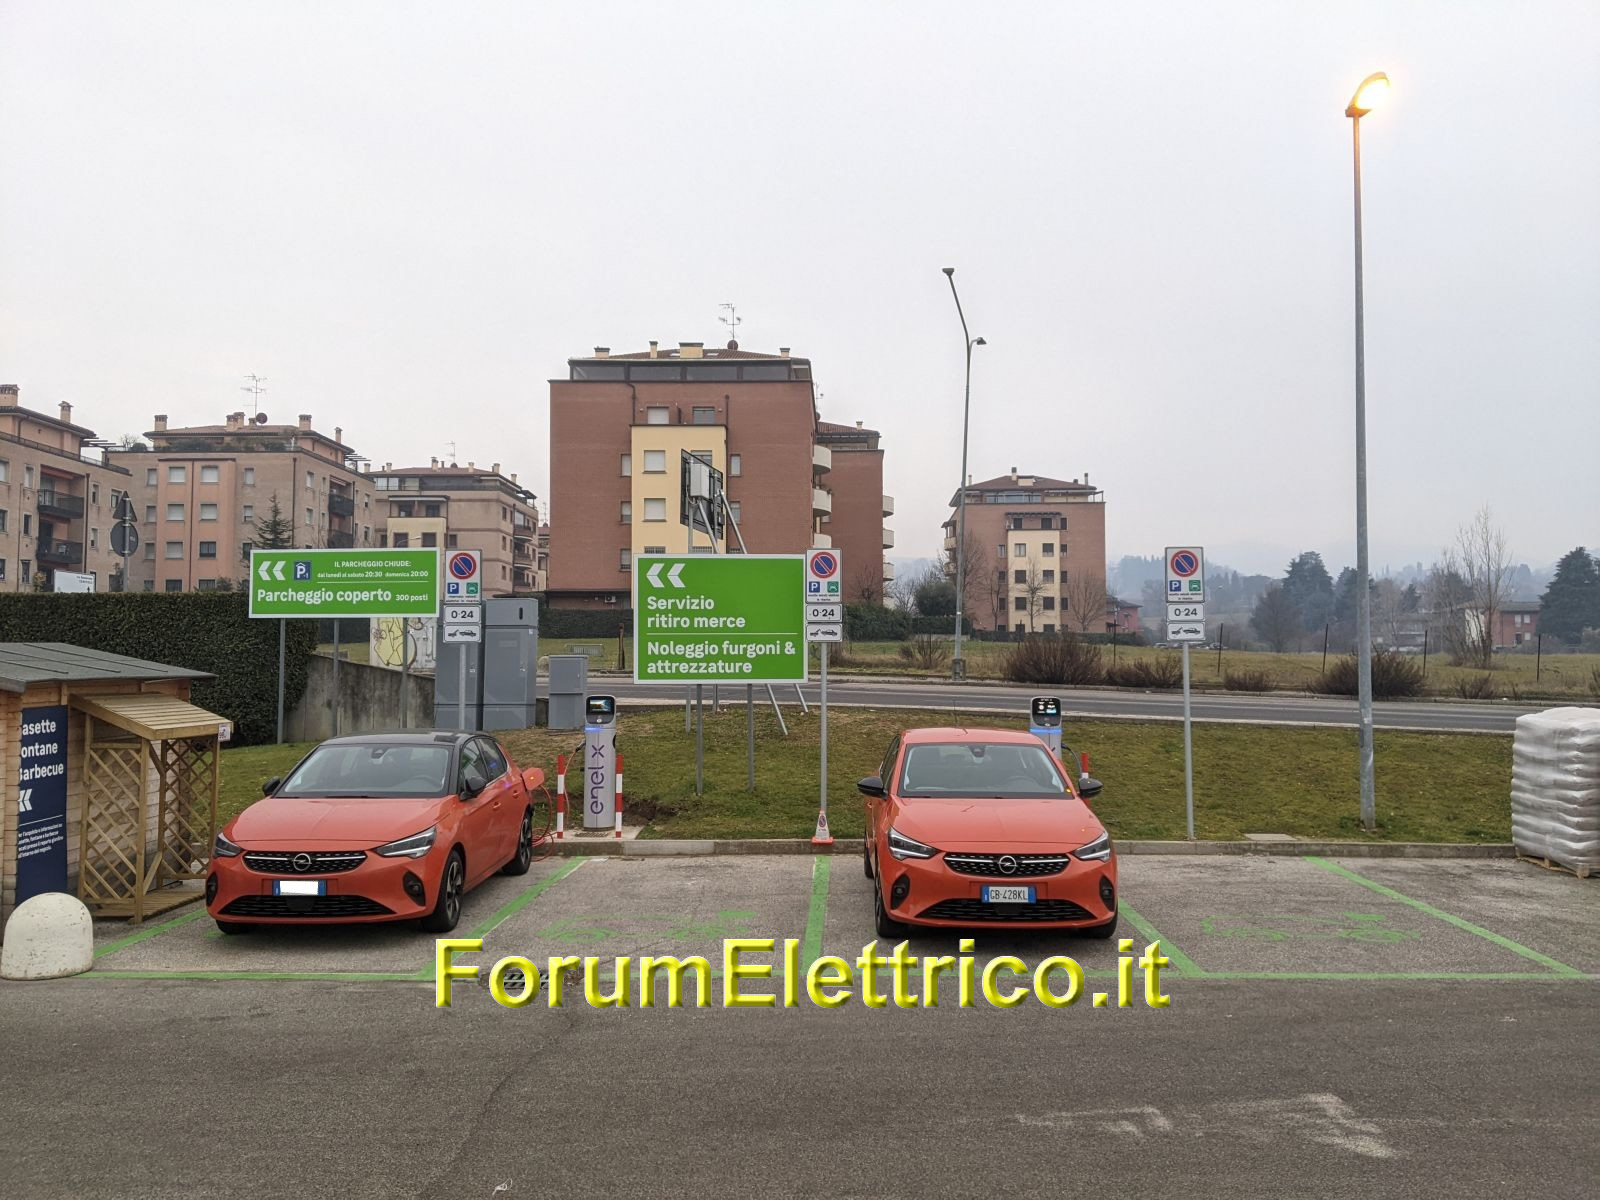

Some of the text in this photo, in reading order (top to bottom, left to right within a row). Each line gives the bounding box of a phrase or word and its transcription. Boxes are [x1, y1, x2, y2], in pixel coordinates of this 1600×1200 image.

[257, 588, 334, 604] Parcheggio
[336, 589, 392, 604] coperto
[410, 594, 428, 602] posti
[647, 595, 715, 610] Servizio
[647, 614, 746, 628] ritiro merce
[647, 640, 796, 659] Noleggio furgoni &
[647, 660, 753, 674] attrezzature
[21, 719, 57, 736] asette
[20, 742, 58, 758] ontane
[588, 766, 604, 814] enel
